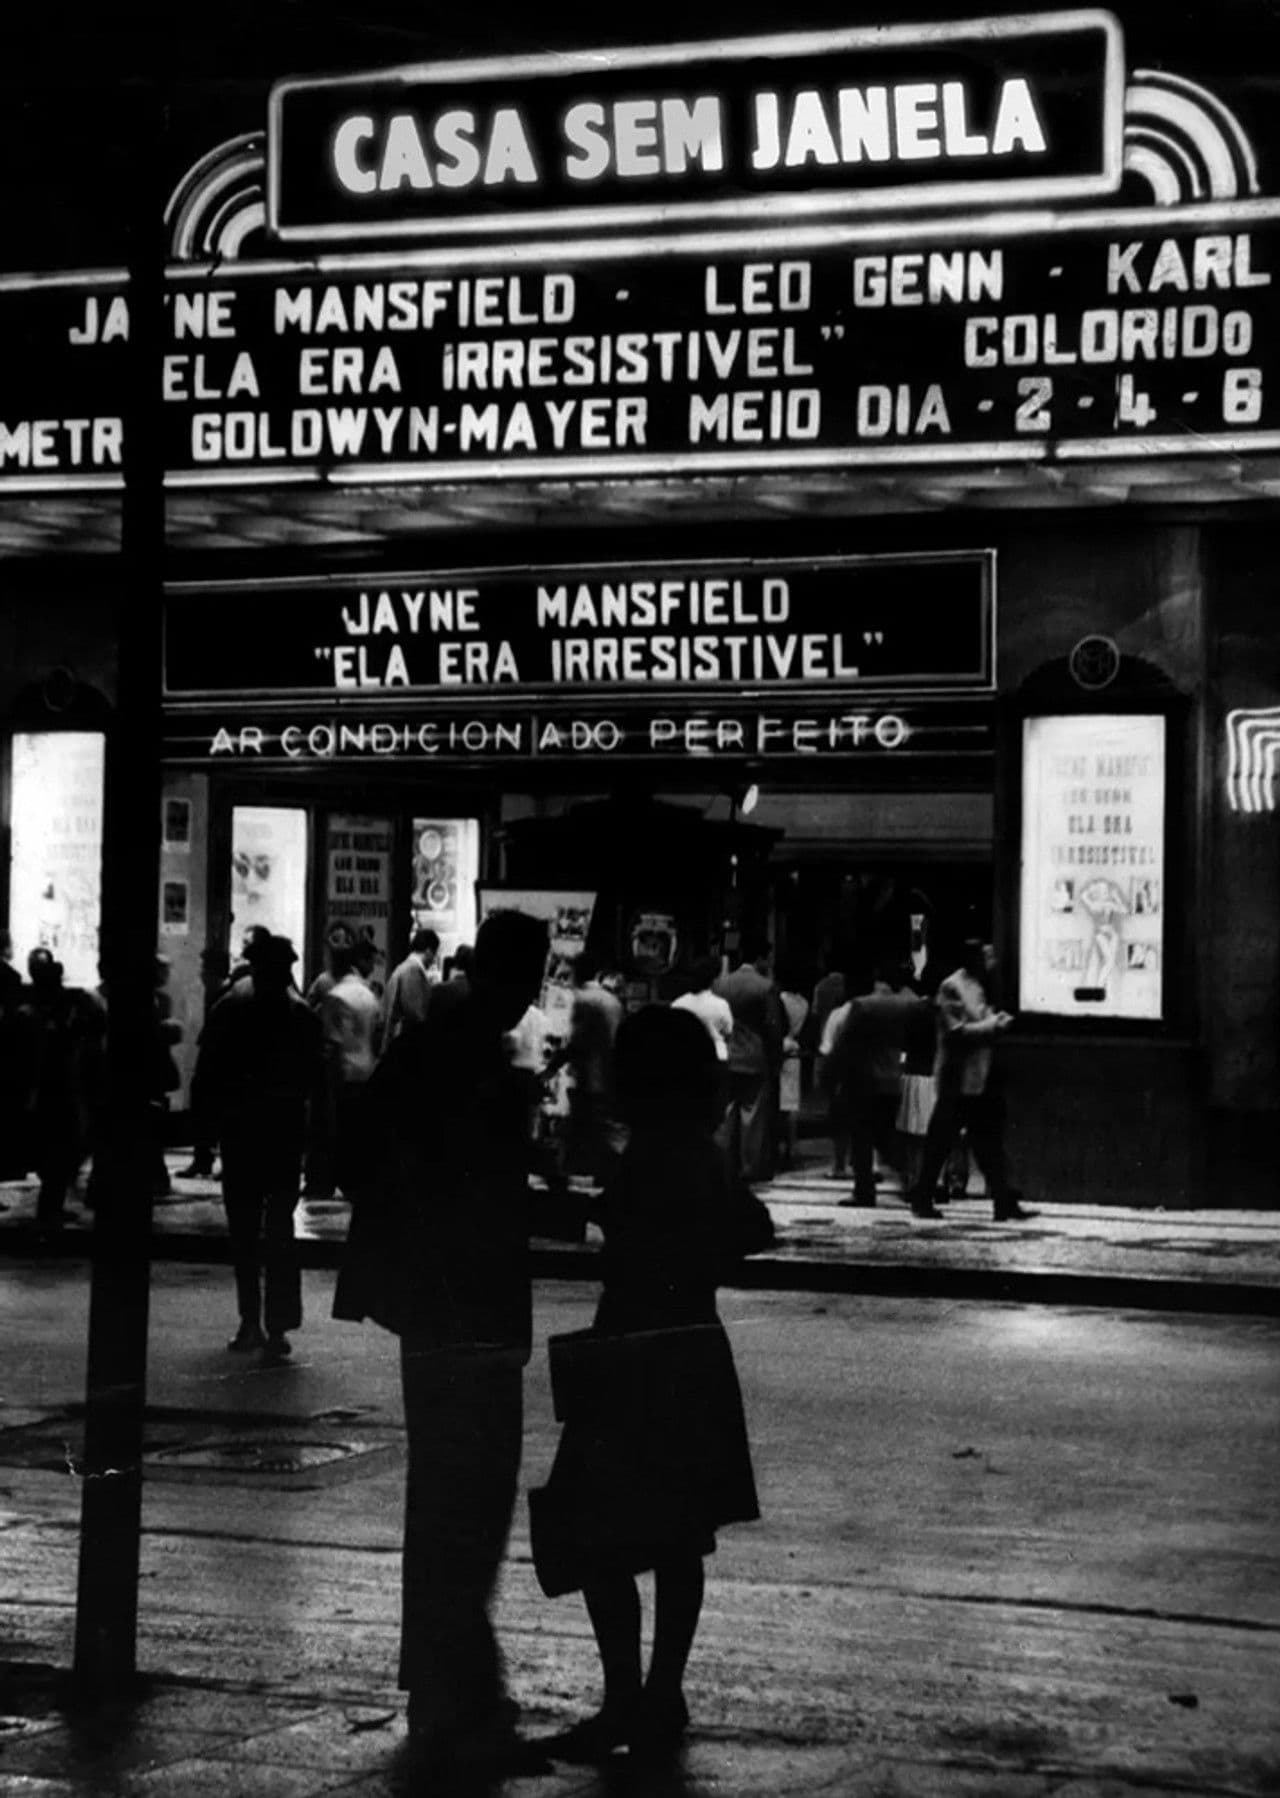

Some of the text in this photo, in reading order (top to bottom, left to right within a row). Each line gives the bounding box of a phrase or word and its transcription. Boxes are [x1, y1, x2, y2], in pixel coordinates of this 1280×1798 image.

[333, 78, 1047, 194] CASA SEM JANELA
[70, 291, 236, 344] JANE
[276, 273, 575, 334] MANSFIELD
[706, 261, 811, 315] LEO
[854, 250, 1003, 307] GENN
[1107, 234, 1271, 294] KARL
[163, 352, 260, 401] ELA
[300, 346, 401, 395] ERA
[0, 418, 124, 468] METR
[689, 389, 821, 443] MEIO
[857, 384, 951, 437] DIA
[1015, 376, 1053, 432] 2
[1118, 373, 1157, 428] 4
[341, 579, 790, 635] JAYNE MANSFIELD
[439, 641, 520, 686] ERA
[209, 726, 264, 754] AR
[650, 714, 907, 754] PERFEITO
